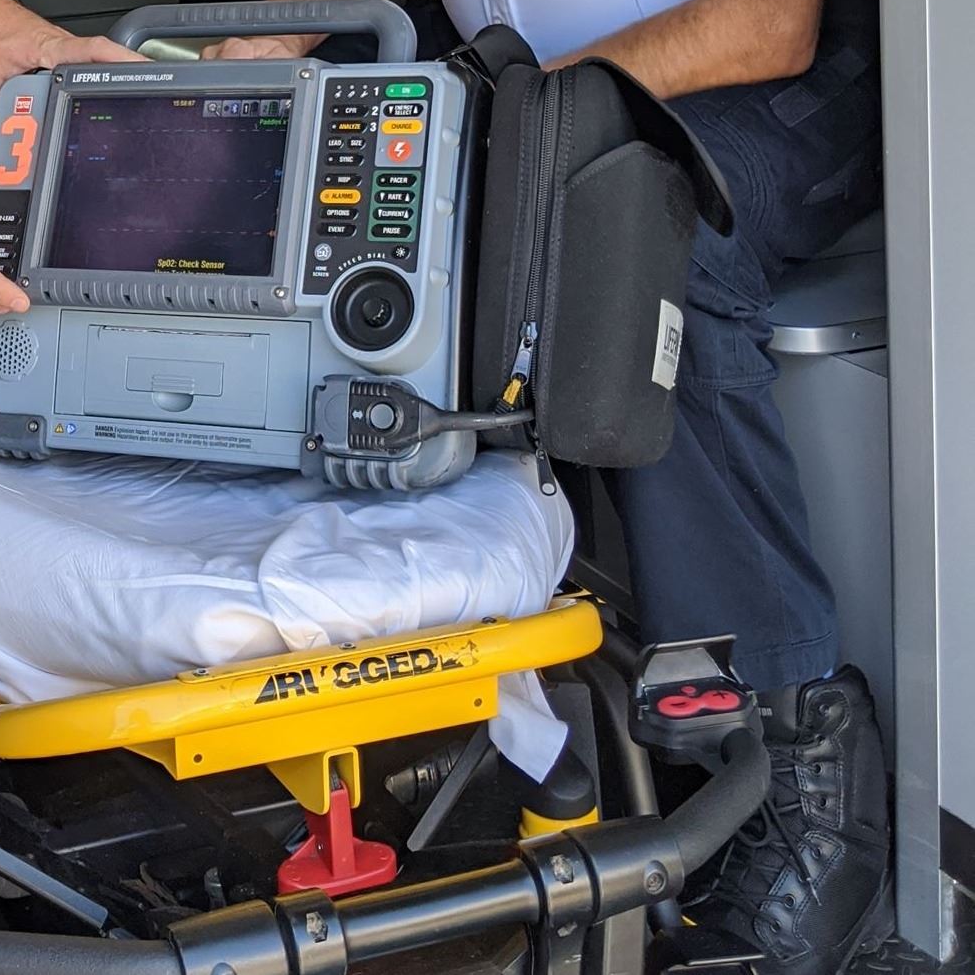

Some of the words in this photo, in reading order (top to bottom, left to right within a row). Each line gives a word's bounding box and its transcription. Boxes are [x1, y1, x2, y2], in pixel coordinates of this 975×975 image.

[72, 74, 101, 83] LIFEPAK
[101, 73, 110, 82] 15
[111, 74, 174, 82] MONITOR/DEFIBRILLATOR
[373, 86, 380, 96] 1
[371, 106, 379, 116] 2
[369, 122, 377, 132] 3
[178, 259, 200, 268] Check
[200, 260, 226, 269] Sensor
[338, 255, 363, 272] SPEED
